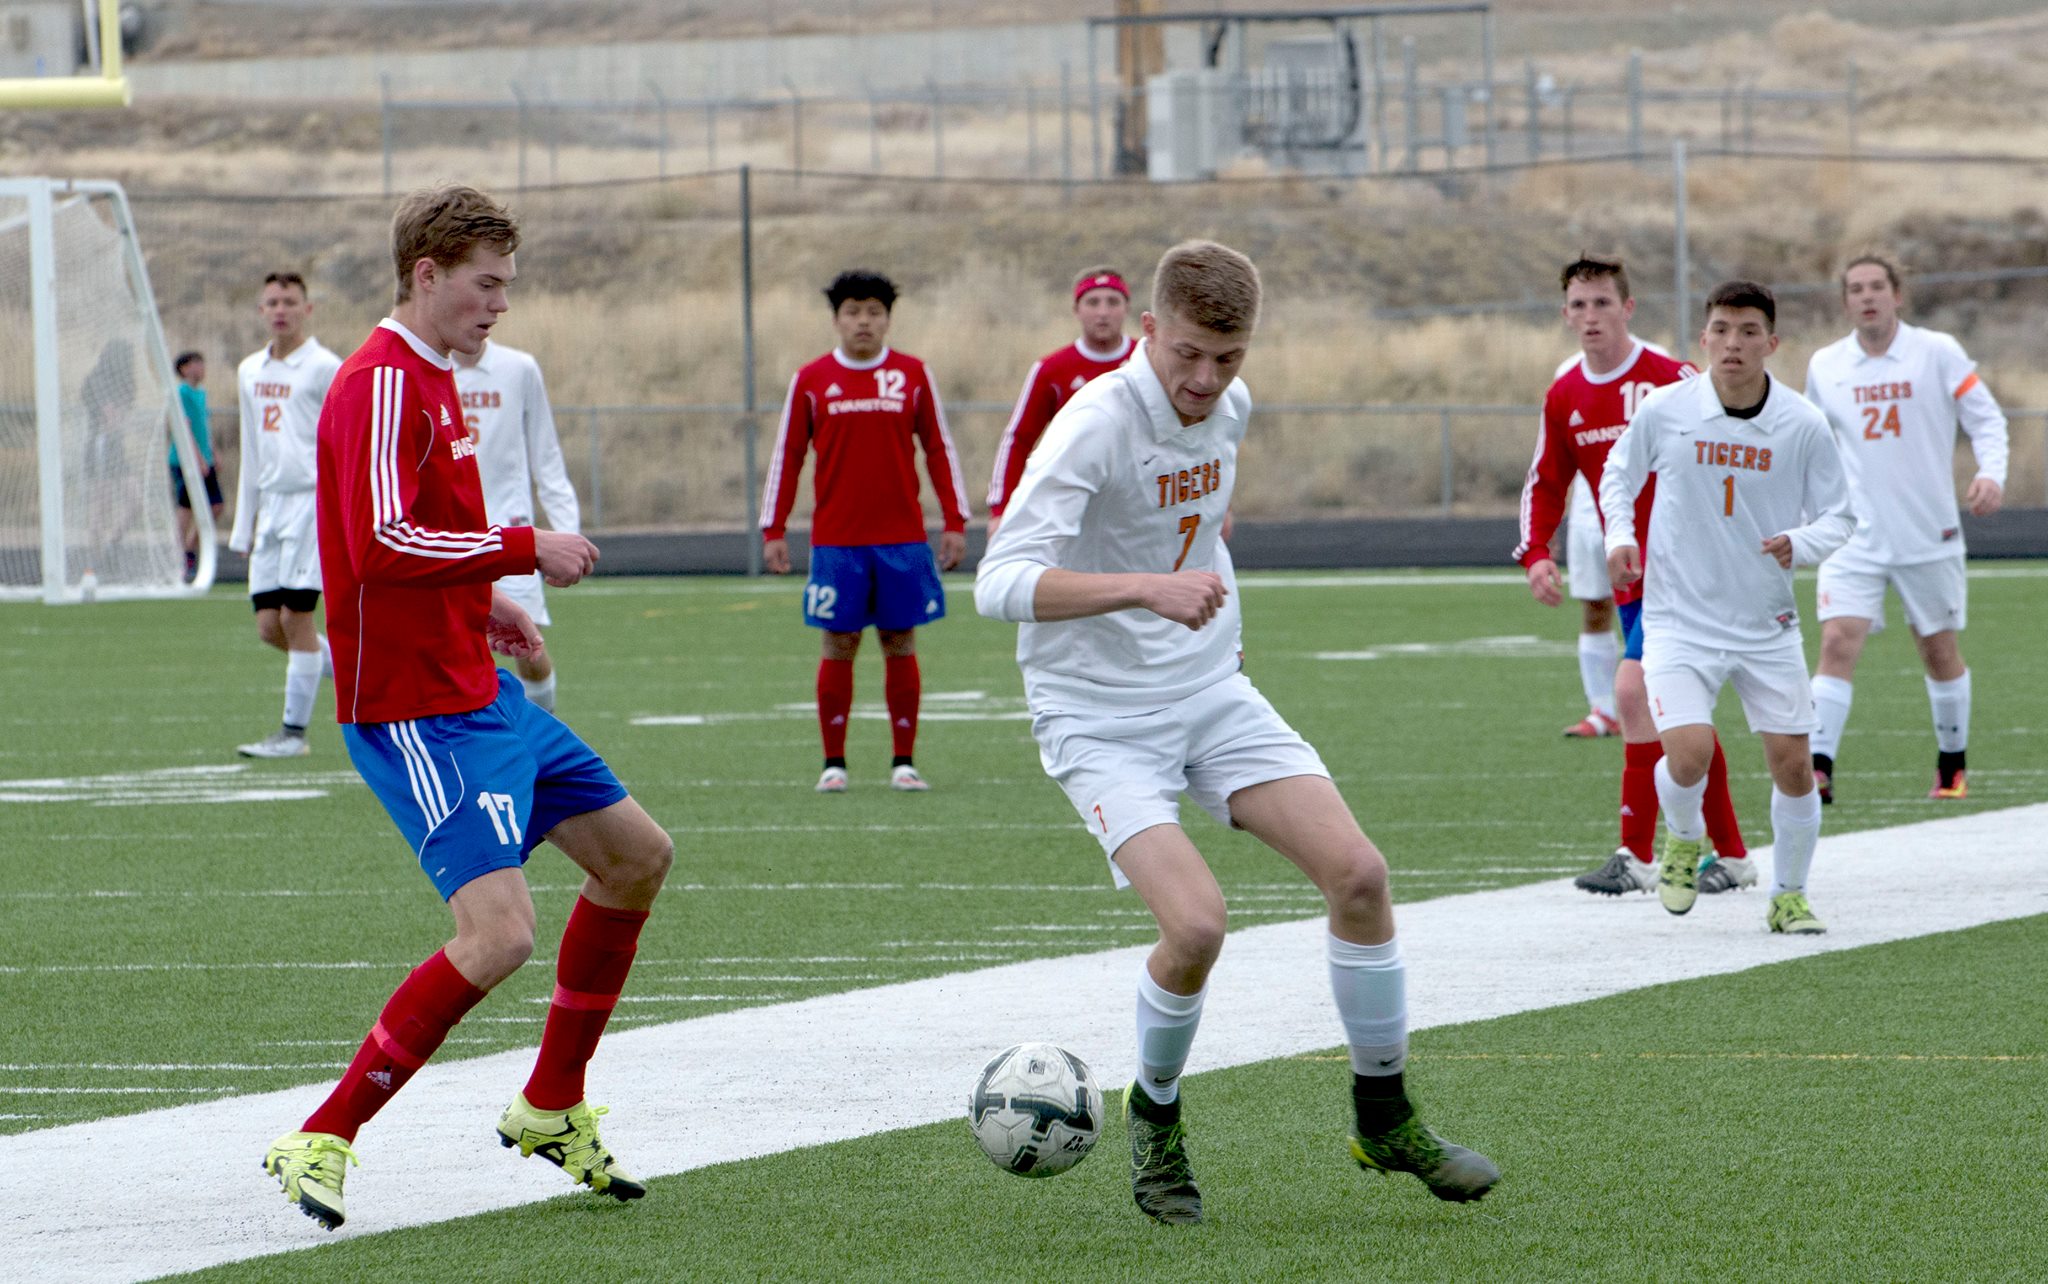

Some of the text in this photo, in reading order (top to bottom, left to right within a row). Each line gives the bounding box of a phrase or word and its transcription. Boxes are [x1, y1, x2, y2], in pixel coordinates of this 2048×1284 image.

[461, 390, 502, 409] GERS
[873, 368, 907, 401] 12
[1853, 381, 1913, 404] TIGERS
[263, 404, 283, 432] 12
[827, 399, 904, 416] EVANSTON
[1861, 403, 1902, 440] 24
[1694, 440, 1773, 473] TIGERS
[1157, 458, 1221, 509] TIGERS
[1722, 474, 1735, 517] 1
[1174, 513, 1201, 573] 7
[806, 583, 838, 620] 12
[476, 791, 523, 845] 17
